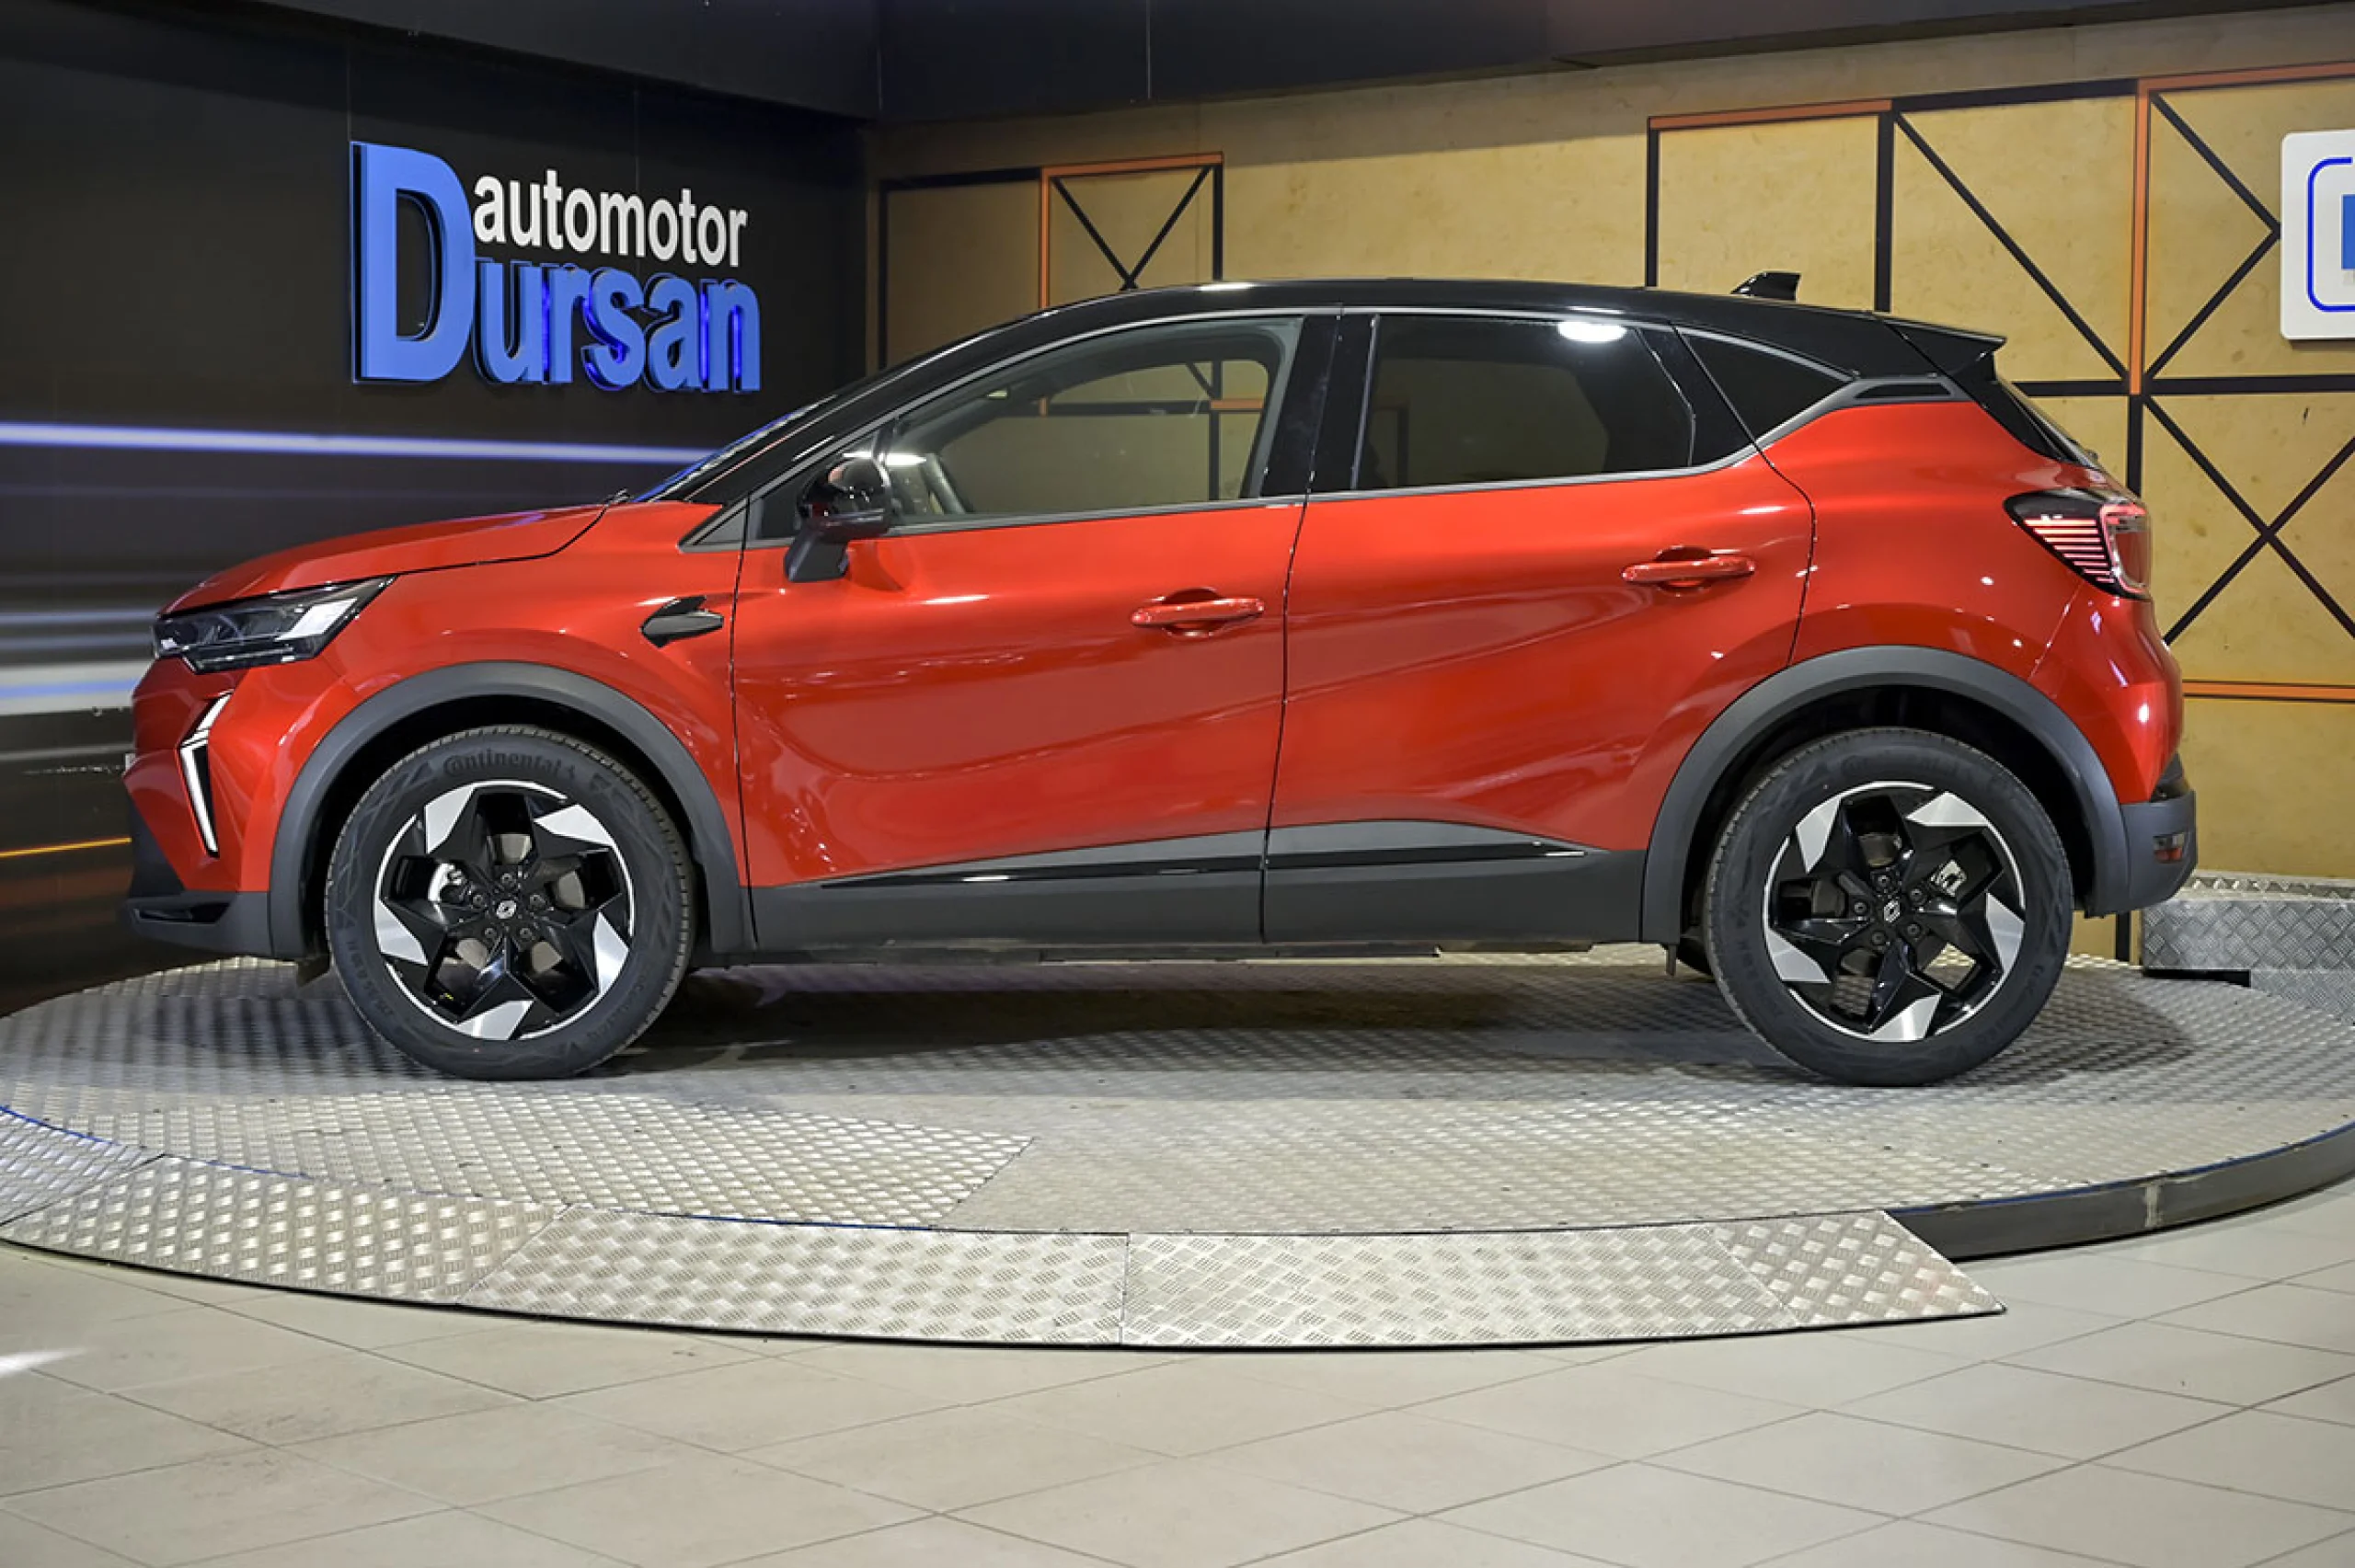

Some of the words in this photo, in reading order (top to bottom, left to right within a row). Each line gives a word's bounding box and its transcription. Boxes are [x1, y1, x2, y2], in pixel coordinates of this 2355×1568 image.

[350, 141, 761, 393] Dursan
[474, 169, 748, 268] automotor
[442, 747, 562, 776] Continental
